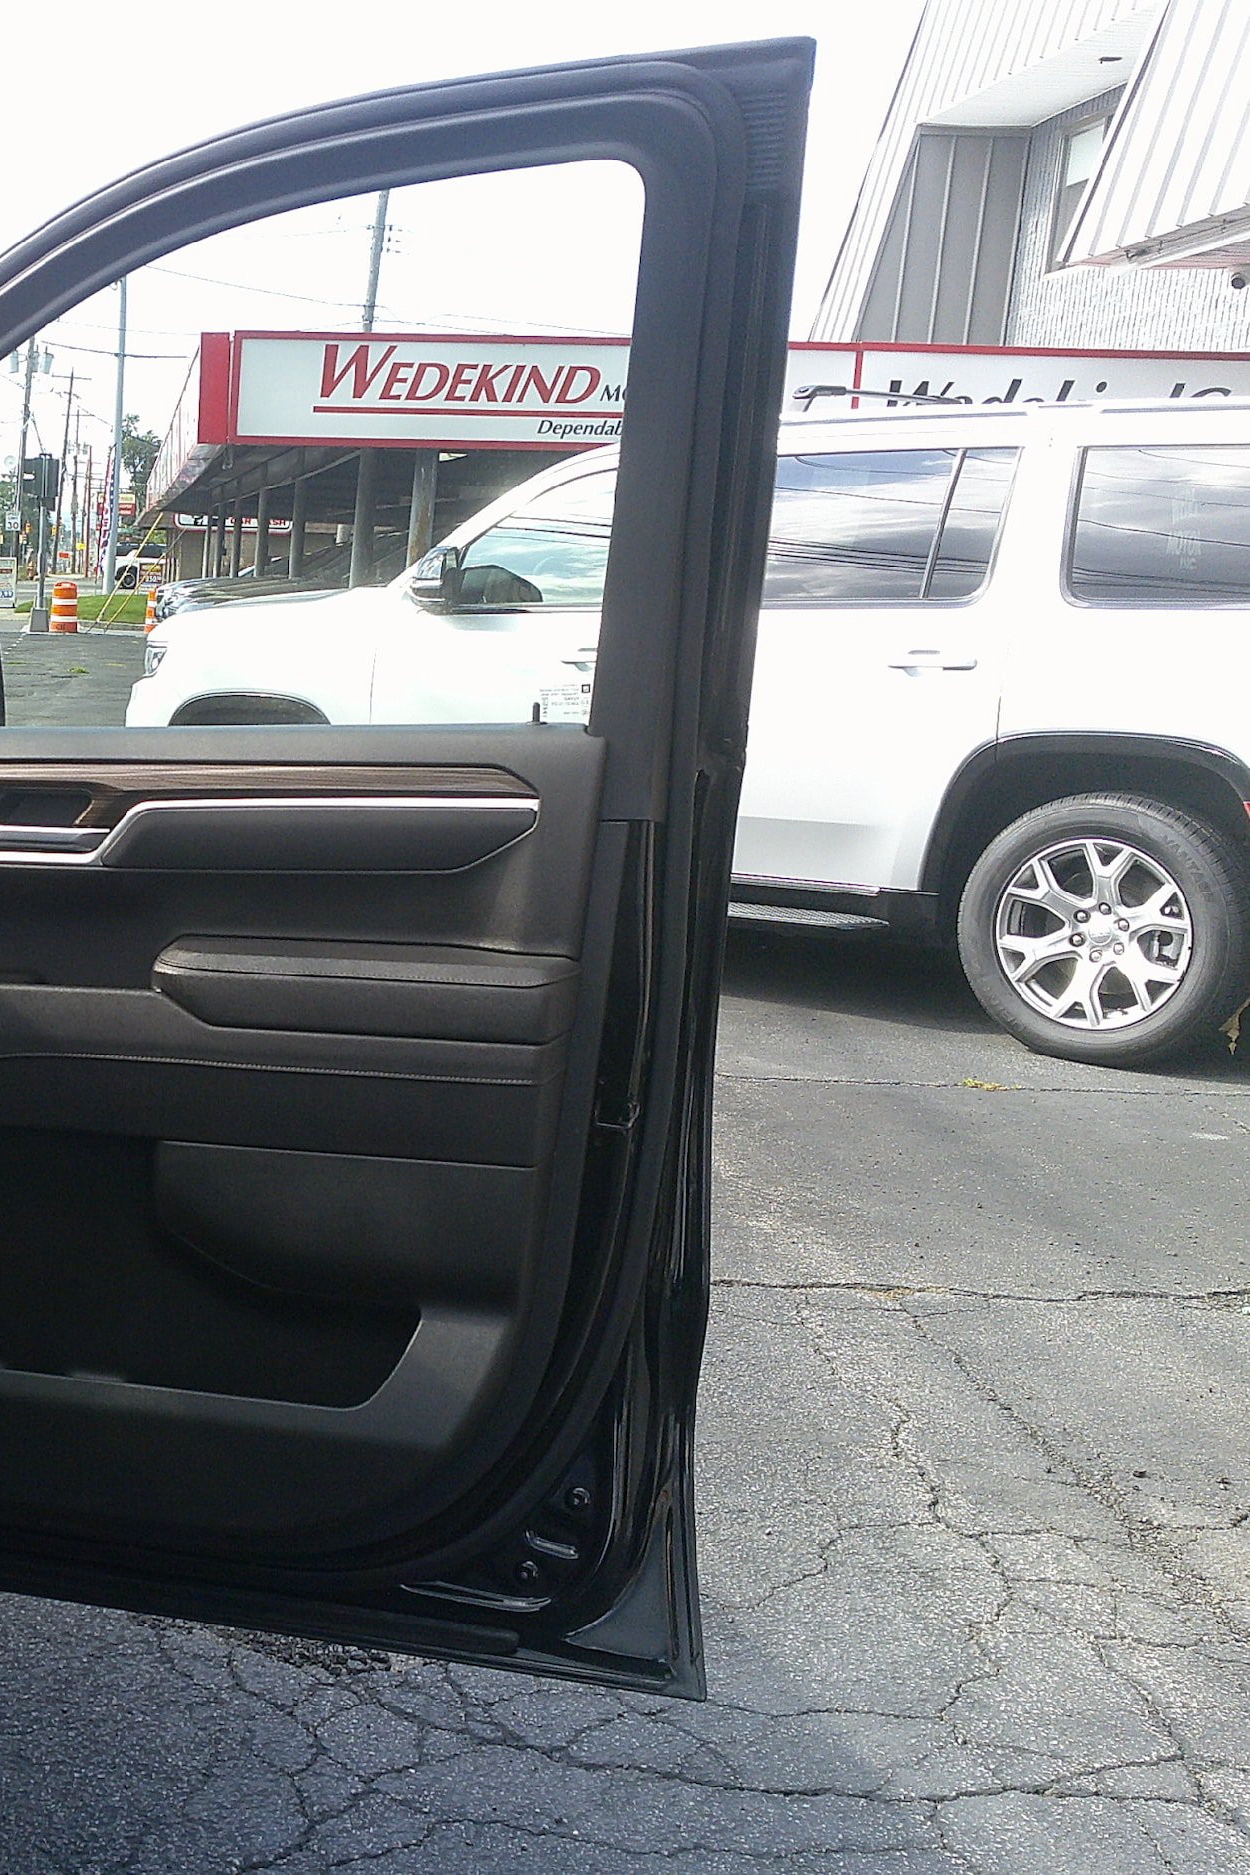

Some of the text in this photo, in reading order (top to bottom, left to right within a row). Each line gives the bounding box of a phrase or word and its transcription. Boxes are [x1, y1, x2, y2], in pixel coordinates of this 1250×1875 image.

[319, 344, 627, 405] WEDEKIND M
[7, 521, 19, 530] 30
